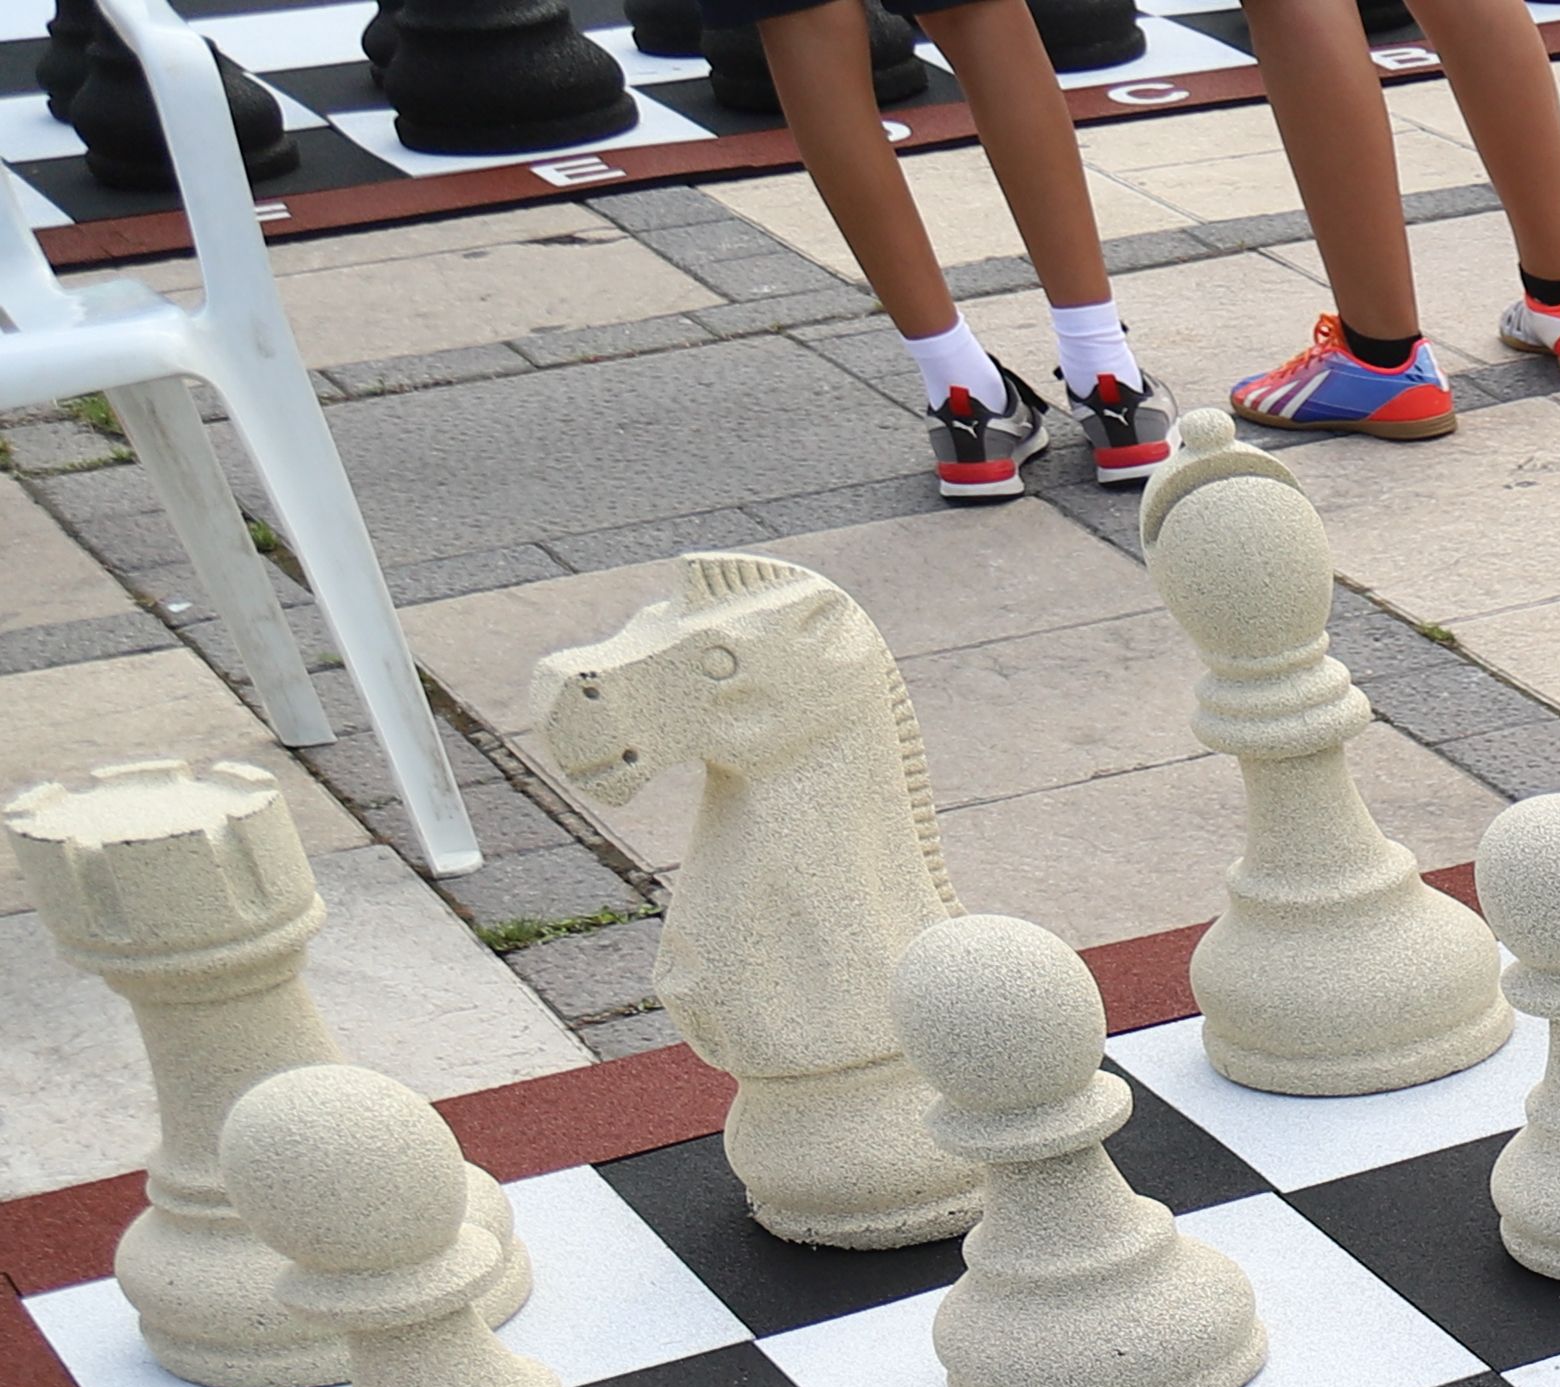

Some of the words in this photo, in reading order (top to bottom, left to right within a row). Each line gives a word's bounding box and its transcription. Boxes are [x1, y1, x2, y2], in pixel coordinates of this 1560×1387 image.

[1370, 48, 1441, 70] B
[1107, 82, 1190, 105] C
[530, 157, 626, 187] E
